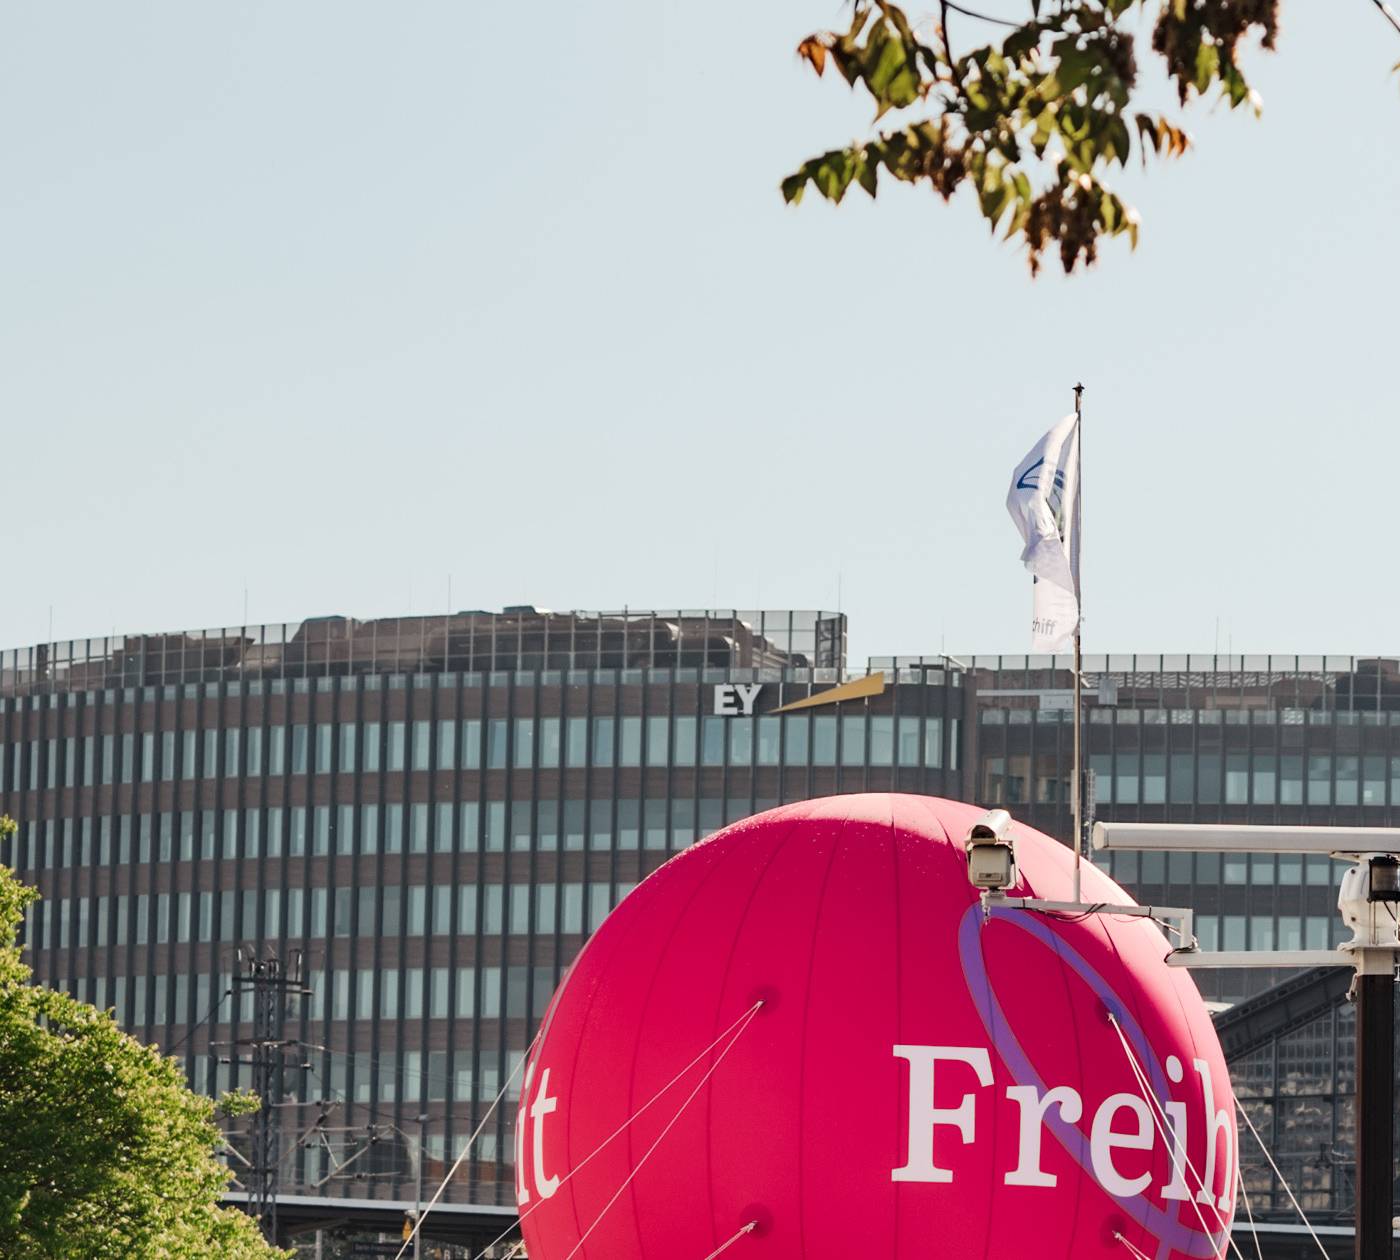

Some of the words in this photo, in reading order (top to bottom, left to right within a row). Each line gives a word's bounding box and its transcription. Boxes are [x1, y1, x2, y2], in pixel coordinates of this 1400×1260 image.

[714, 684, 763, 715] EY
[514, 1061, 560, 1206] it
[891, 1044, 1233, 1213] Freih
